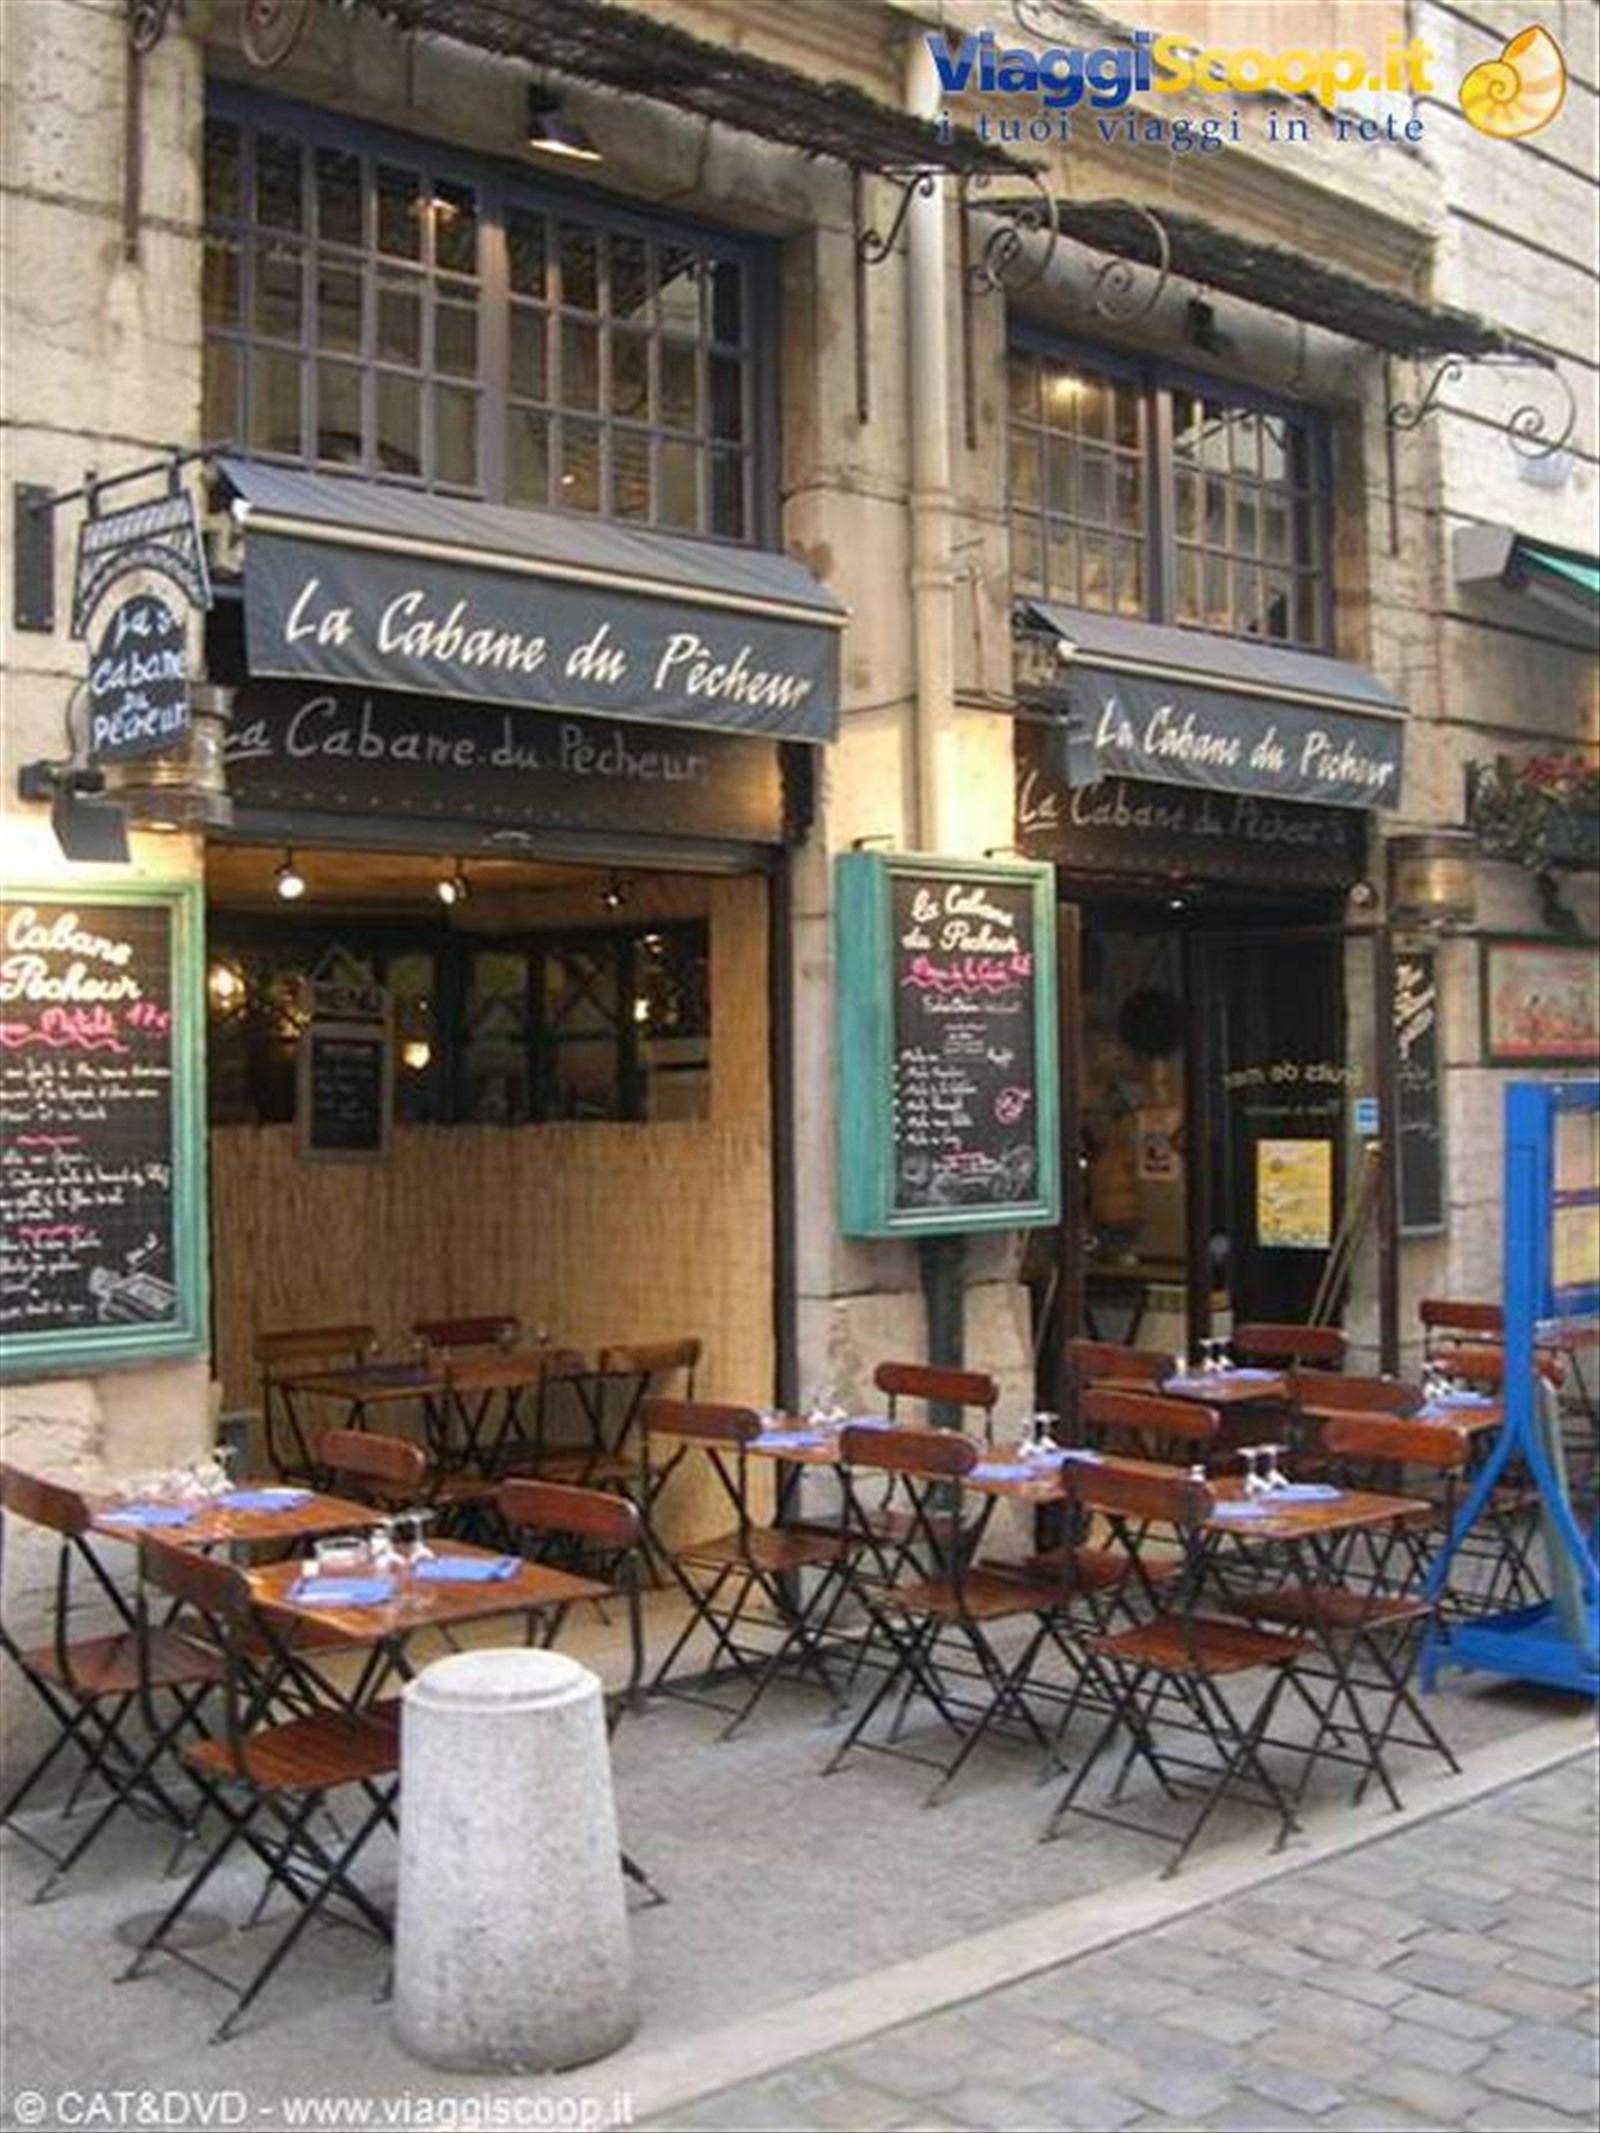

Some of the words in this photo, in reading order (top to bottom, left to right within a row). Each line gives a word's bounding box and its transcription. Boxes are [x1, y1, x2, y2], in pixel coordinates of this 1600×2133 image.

[285, 578, 353, 645] La
[377, 590, 546, 673] Cabane
[565, 622, 626, 684] du
[654, 633, 813, 709] Pêcheur
[1096, 698, 1134, 749] La
[1143, 706, 1240, 765] Cabane
[1250, 724, 1284, 771] du
[1301, 730, 1394, 787] Pêcheur
[1019, 769, 1059, 824] La
[6, 906, 133, 966] Cabane
